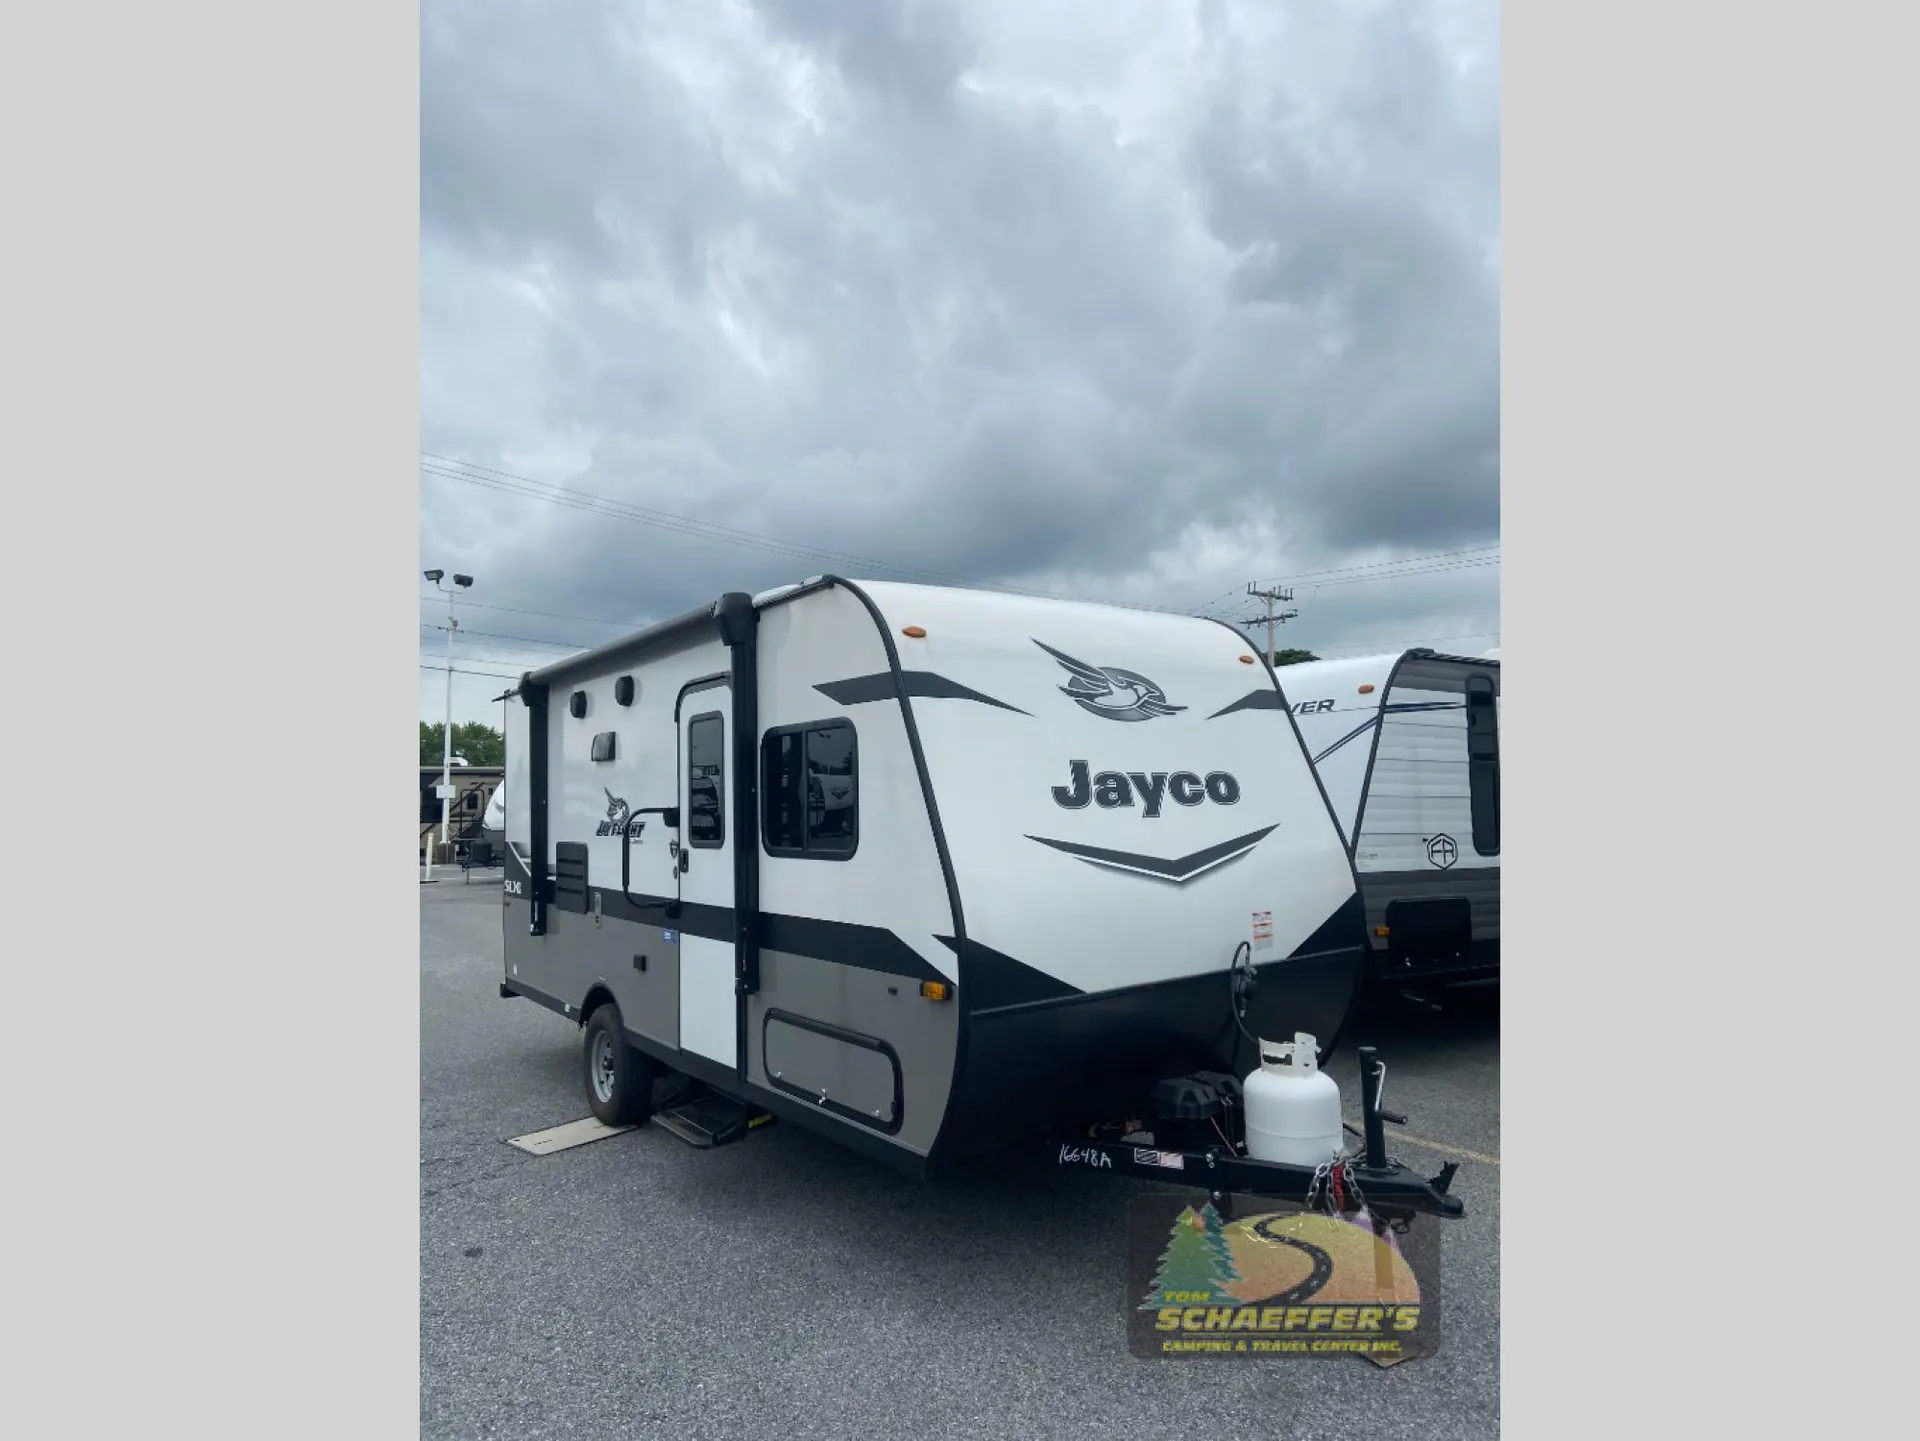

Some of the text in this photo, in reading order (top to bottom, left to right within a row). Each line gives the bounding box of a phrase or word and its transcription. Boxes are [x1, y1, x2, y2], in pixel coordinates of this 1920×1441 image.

[1051, 759, 1241, 818] Jayco
[611, 821, 646, 838] FLHT
[1059, 1143, 1112, 1168] 16648A
